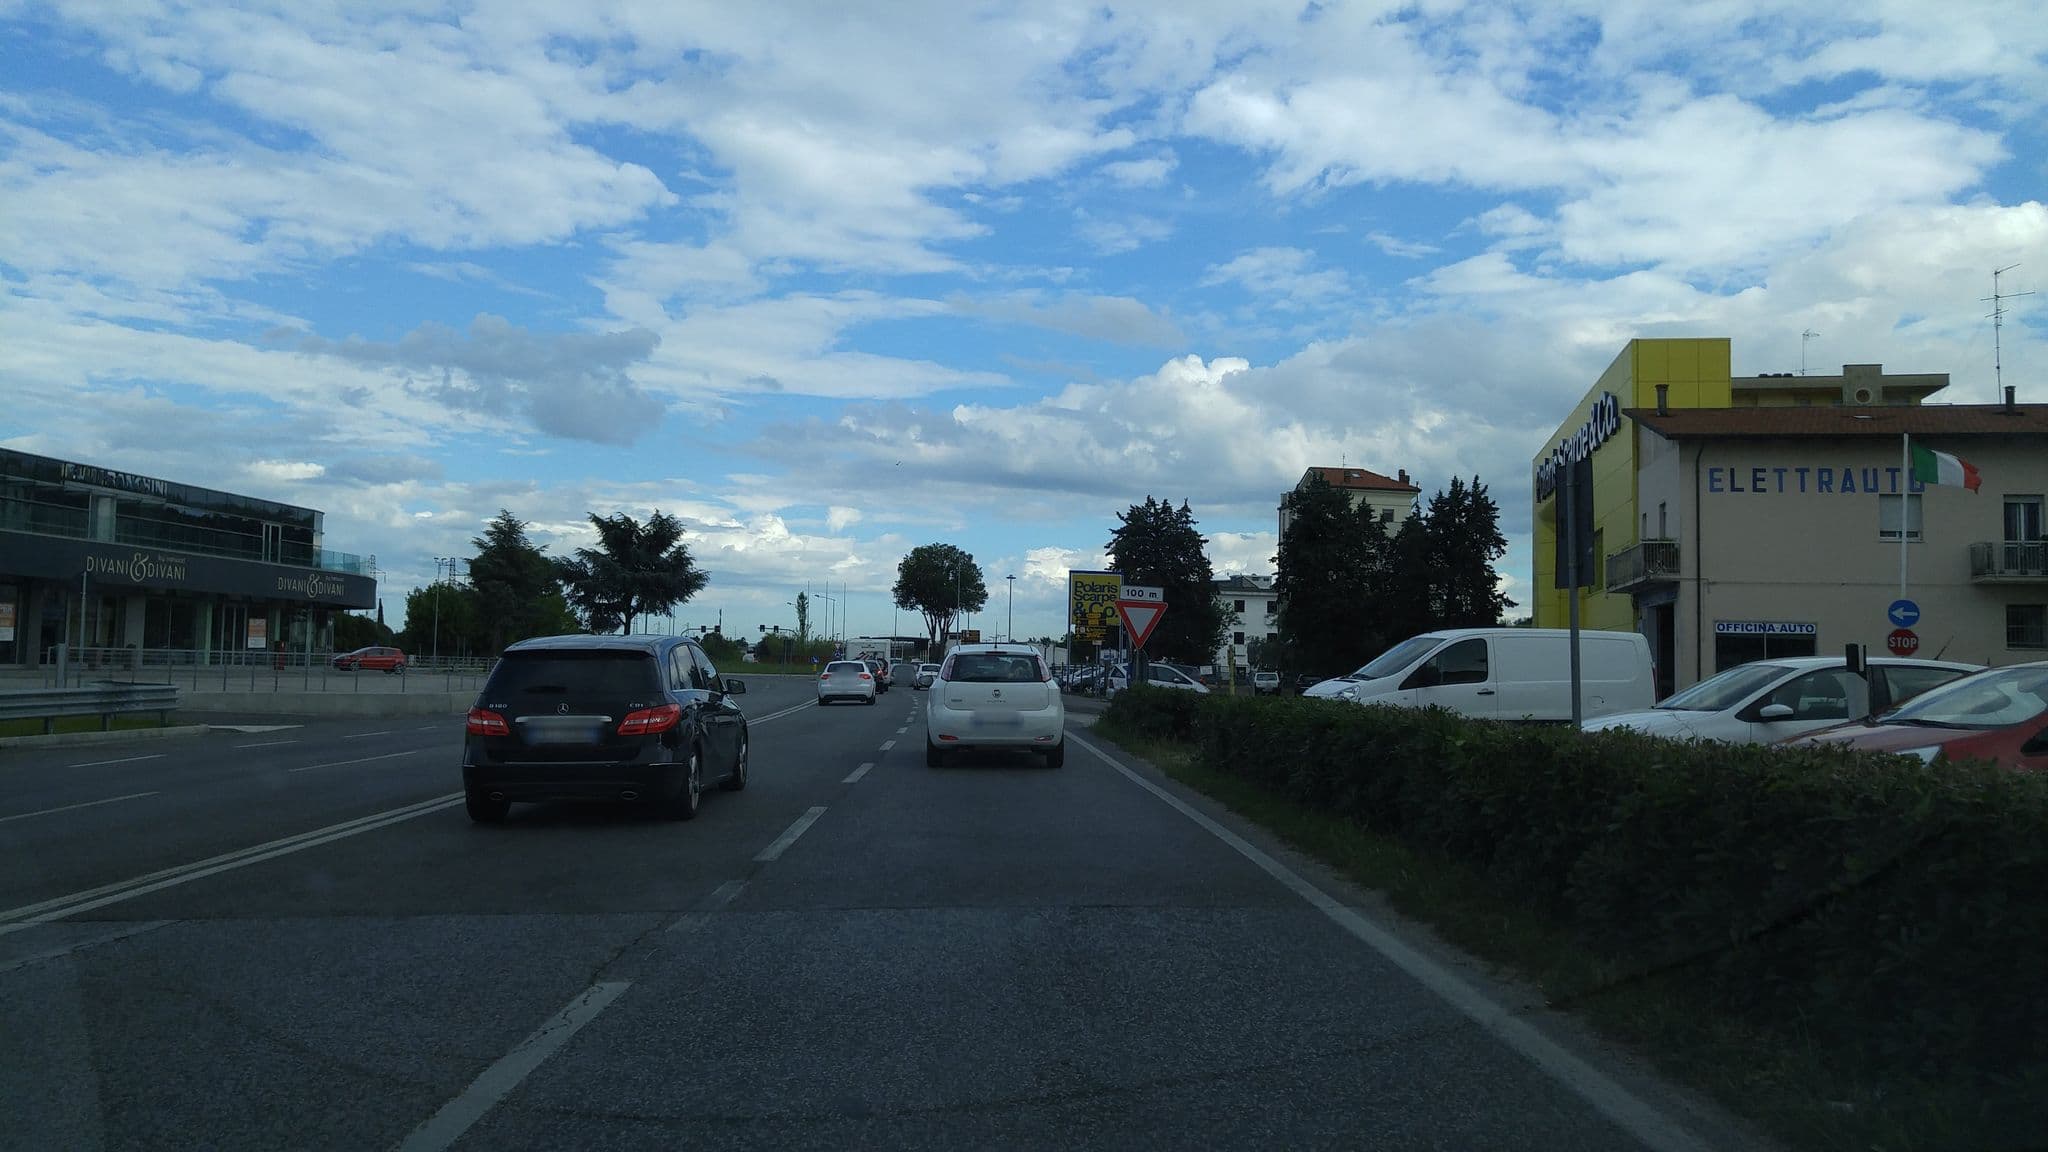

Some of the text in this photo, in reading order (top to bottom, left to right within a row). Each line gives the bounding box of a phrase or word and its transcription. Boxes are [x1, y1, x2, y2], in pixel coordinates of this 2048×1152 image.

[1075, 581, 1118, 594] Polaris
[1126, 589, 1144, 597] 100
[1074, 591, 1117, 602] Scarpe
[1889, 637, 1917, 648] STOP
